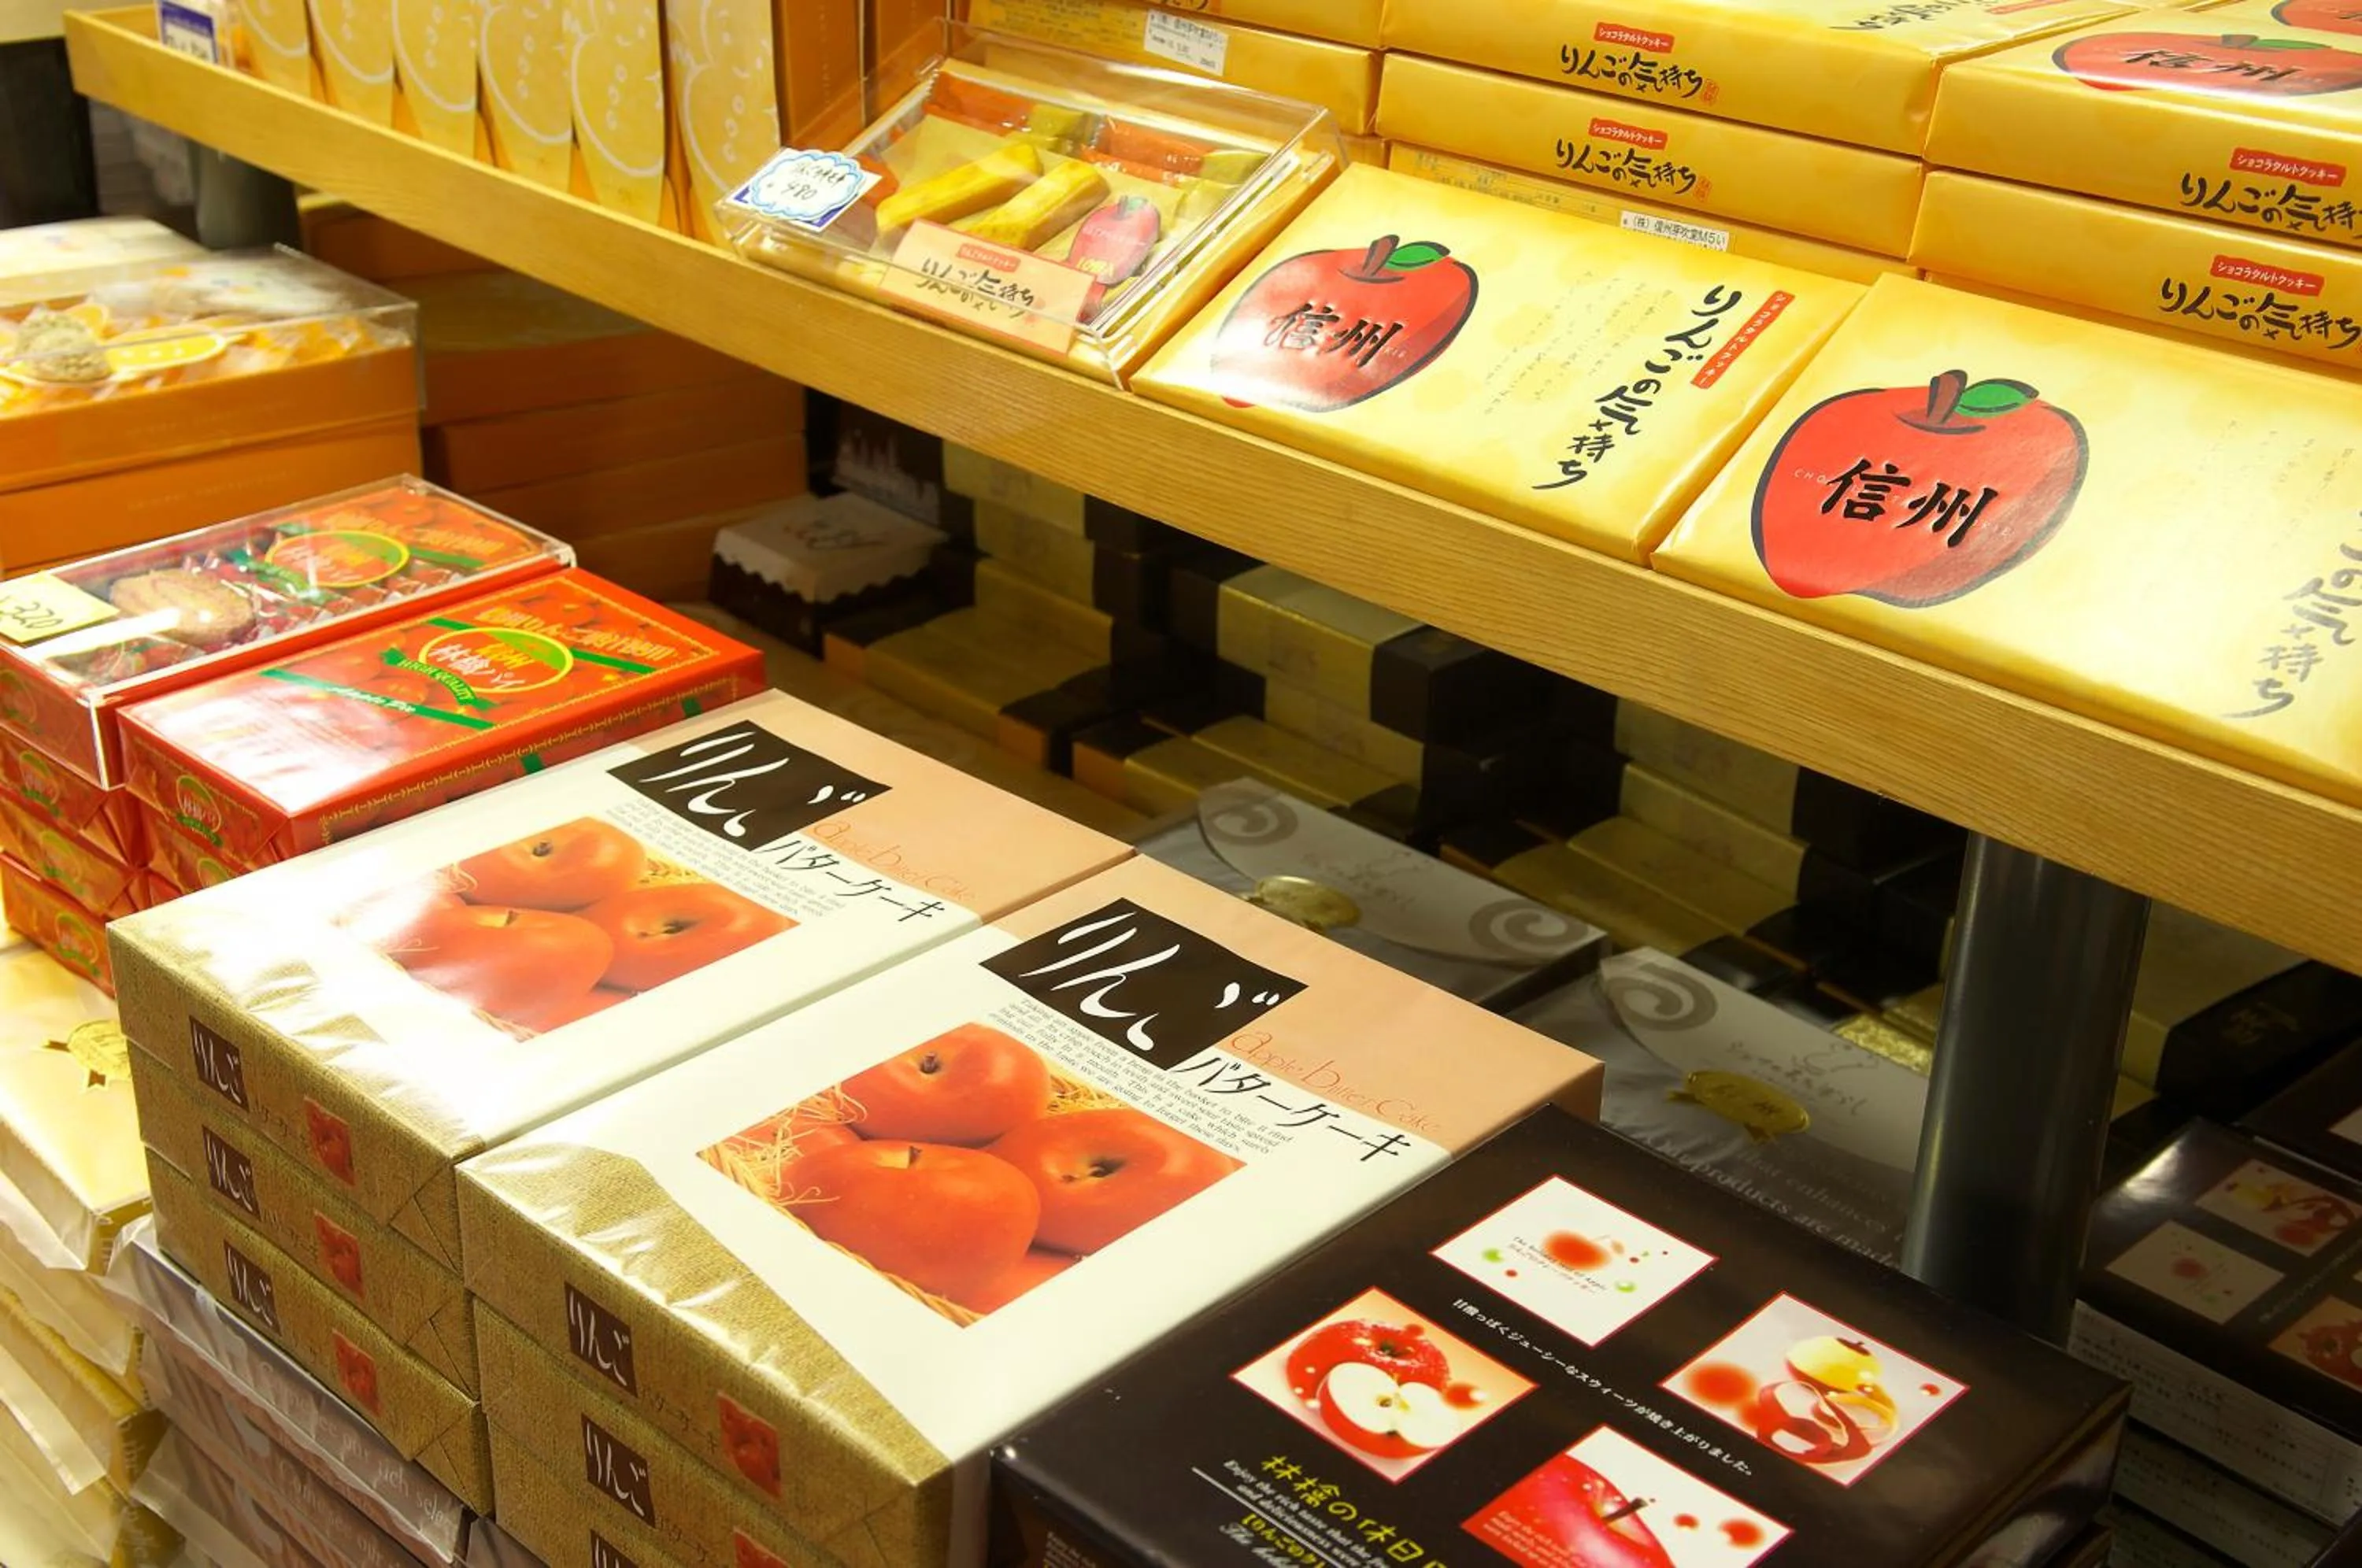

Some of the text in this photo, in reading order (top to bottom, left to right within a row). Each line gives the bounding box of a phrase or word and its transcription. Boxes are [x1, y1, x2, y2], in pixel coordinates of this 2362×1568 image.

[1560, 43, 1704, 98] りんごの気持ち
[1555, 138, 1697, 194] りんごの気持ち
[2179, 172, 2362, 240] りんごの気持
[2236, 153, 2339, 180] ショコラタルトクッキー
[2157, 277, 2362, 350] りんごの気持ち
[2216, 261, 2318, 290] ショコラタルトクッキー
[1263, 302, 1405, 368] 信州
[1531, 284, 1742, 490] りんごの気持ち
[1820, 458, 2000, 549] 信州
[2220, 508, 2362, 719] の気持ち
[638, 729, 867, 839] りんご
[755, 839, 946, 922] バターケーキ
[1017, 911, 1280, 1052] りんご
[1172, 1056, 1412, 1162] バターケーキ
[569, 1290, 630, 1387] りんご
[587, 1422, 646, 1518] りんご
[1275, 1493, 1301, 1512] rich
[1326, 1527, 1352, 1547] that
